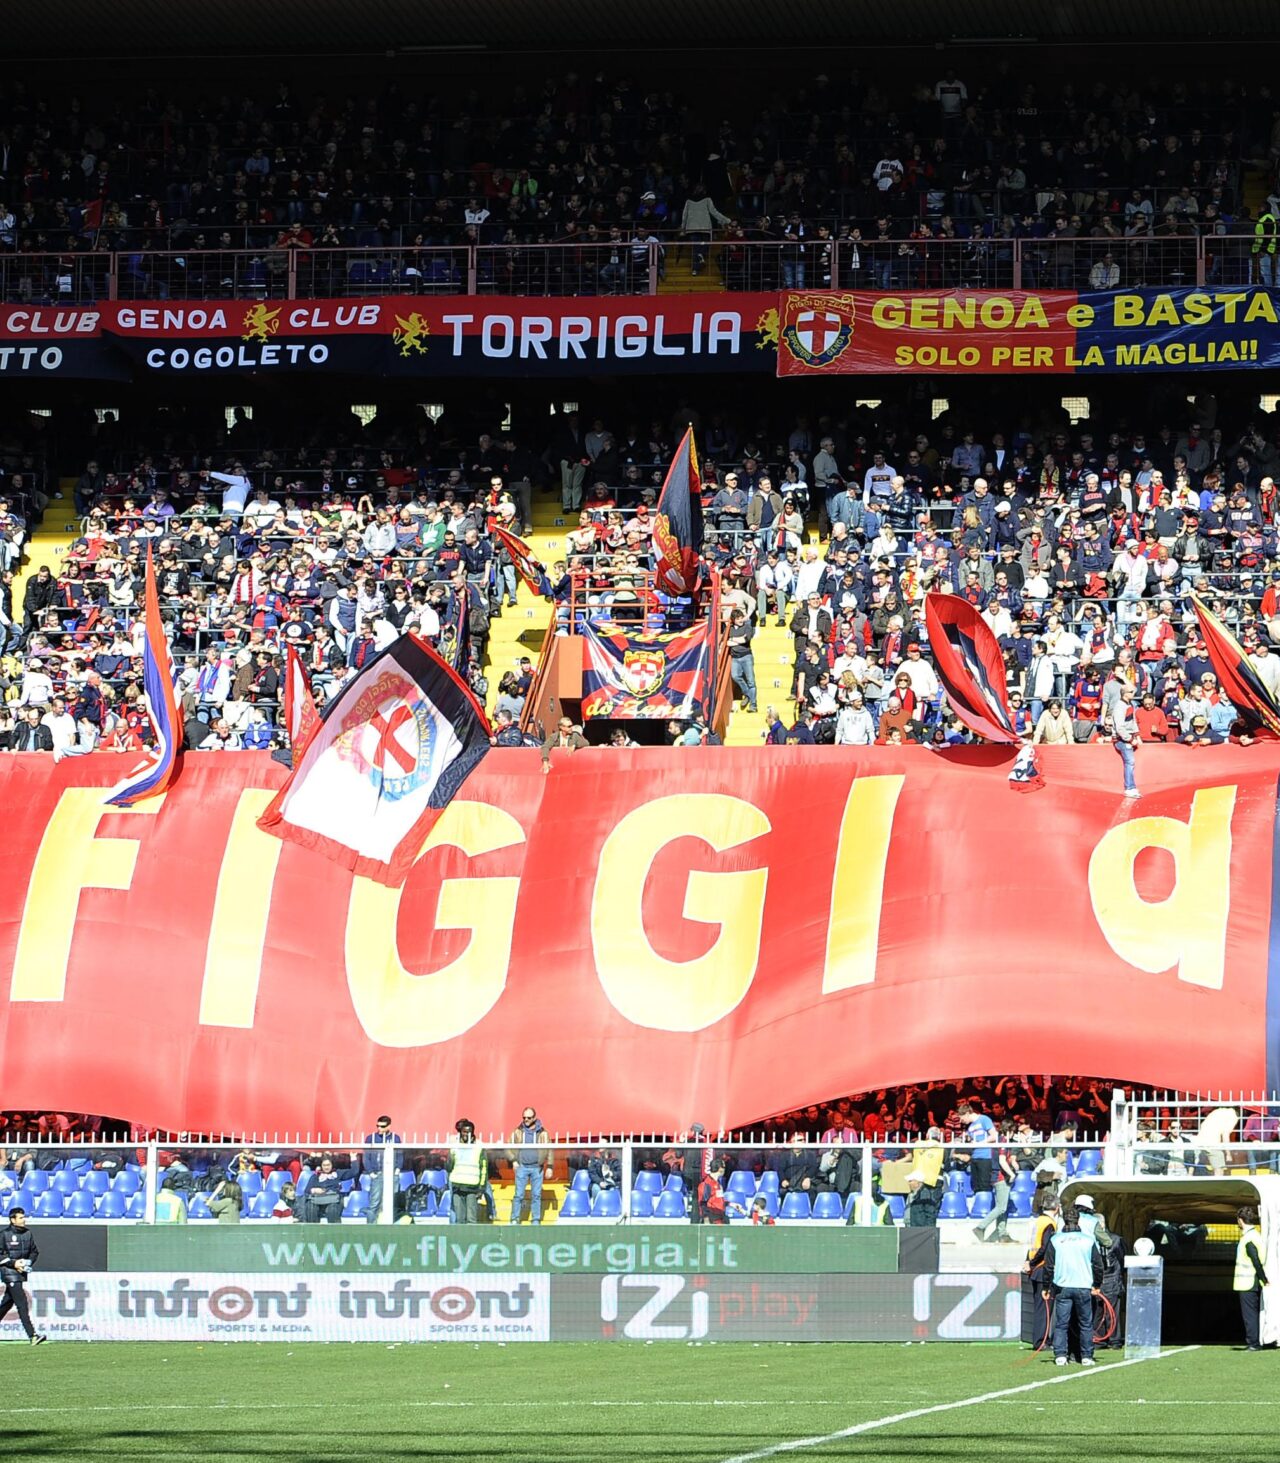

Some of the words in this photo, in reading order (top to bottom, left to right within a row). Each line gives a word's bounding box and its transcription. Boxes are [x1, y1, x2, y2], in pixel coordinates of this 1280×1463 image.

[6, 312, 100, 333] CLUB
[117, 309, 227, 329] GENOA
[289, 305, 380, 327] CLUB
[871, 297, 1050, 329] GENOA
[1066, 304, 1095, 328] e
[1113, 292, 1278, 326] BASTA
[442, 311, 741, 359] TORRIGLIA
[146, 344, 329, 369] COGOLETO
[895, 346, 981, 366] SOLO
[992, 347, 1053, 366] PER
[1065, 347, 1105, 366] LA
[1115, 340, 1258, 365] MAGLIA!!
[9, 775, 906, 1048] FIGGI
[262, 1235, 738, 1272] www.flyenergia.it
[118, 1279, 312, 1321] infront
[339, 1279, 534, 1321] infront
[50, 1323, 89, 1331] MEDIA
[208, 1324, 256, 1332] SPORTS
[259, 1324, 268, 1332] &
[272, 1324, 312, 1332] MEDIA
[430, 1324, 478, 1332] SPORTS
[482, 1324, 490, 1332] &
[494, 1324, 534, 1332] MEDIA
